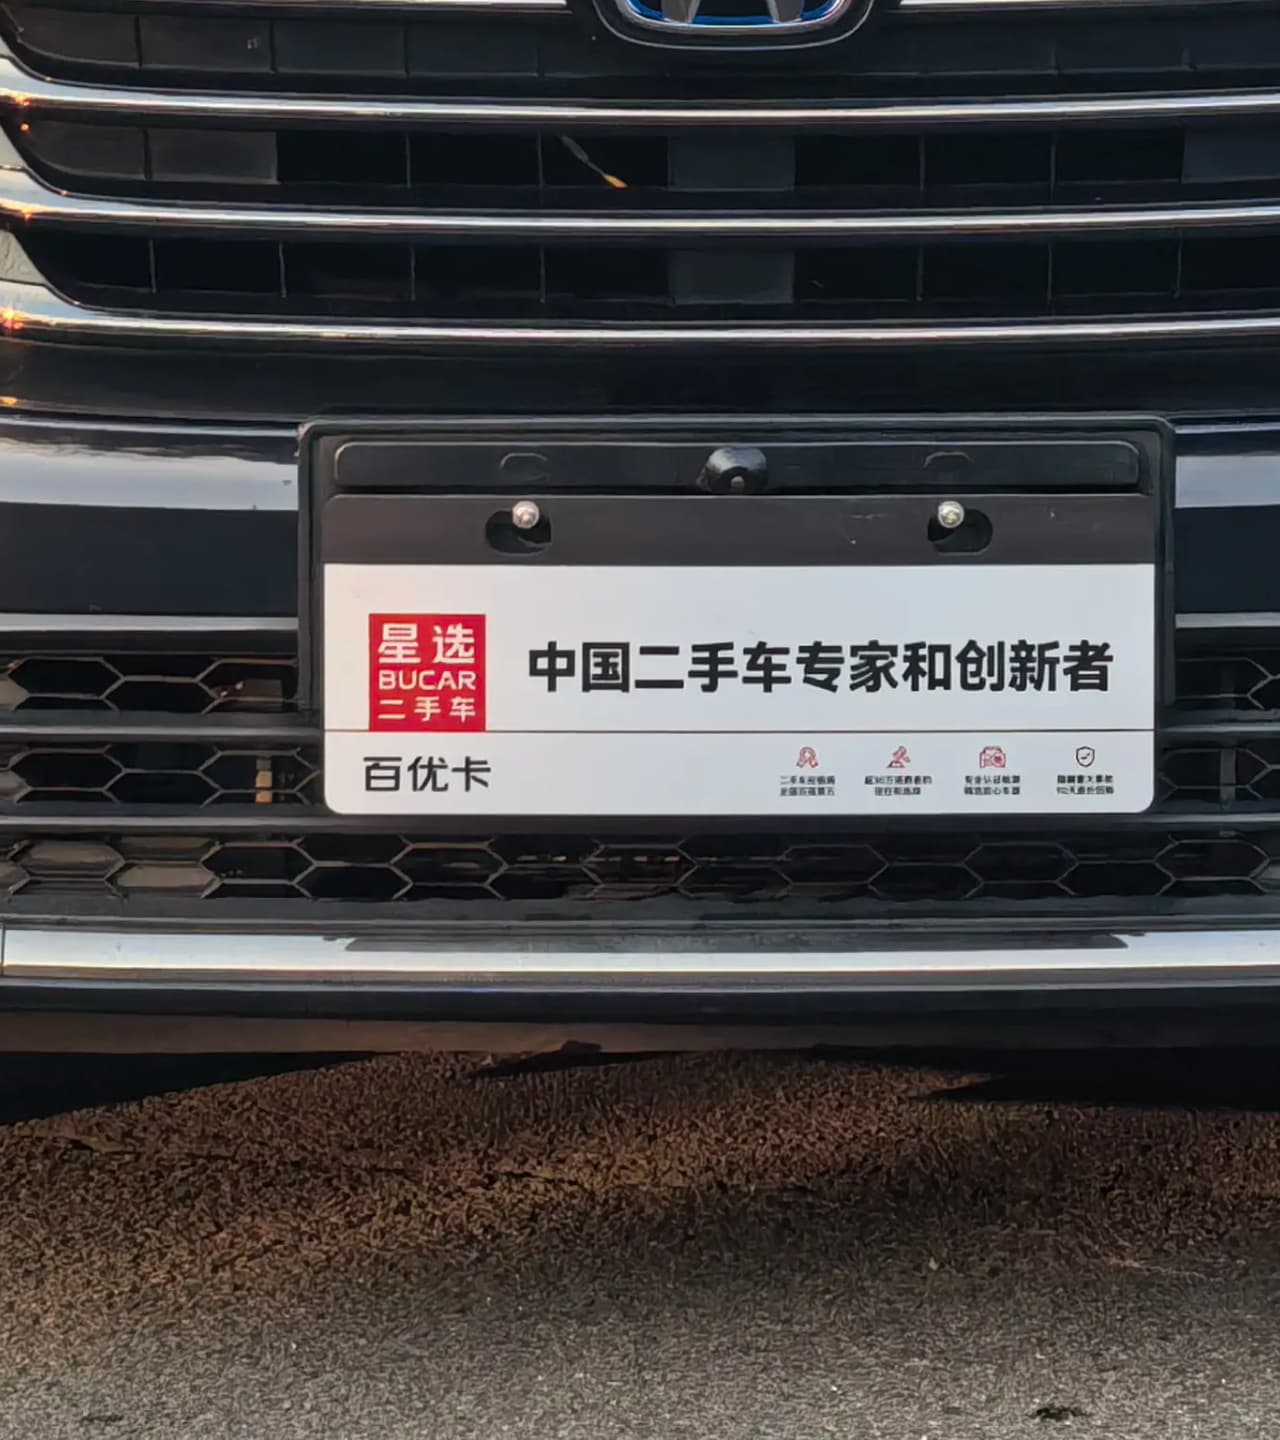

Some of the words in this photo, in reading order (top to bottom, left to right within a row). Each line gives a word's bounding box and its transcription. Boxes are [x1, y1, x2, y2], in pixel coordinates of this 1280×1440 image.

[378, 623, 475, 665] 星选
[378, 670, 477, 691] BUCAR
[528, 639, 1114, 694] 中国二手车专家和创新者
[377, 696, 476, 723] 二手车
[363, 756, 491, 793] 百优卡
